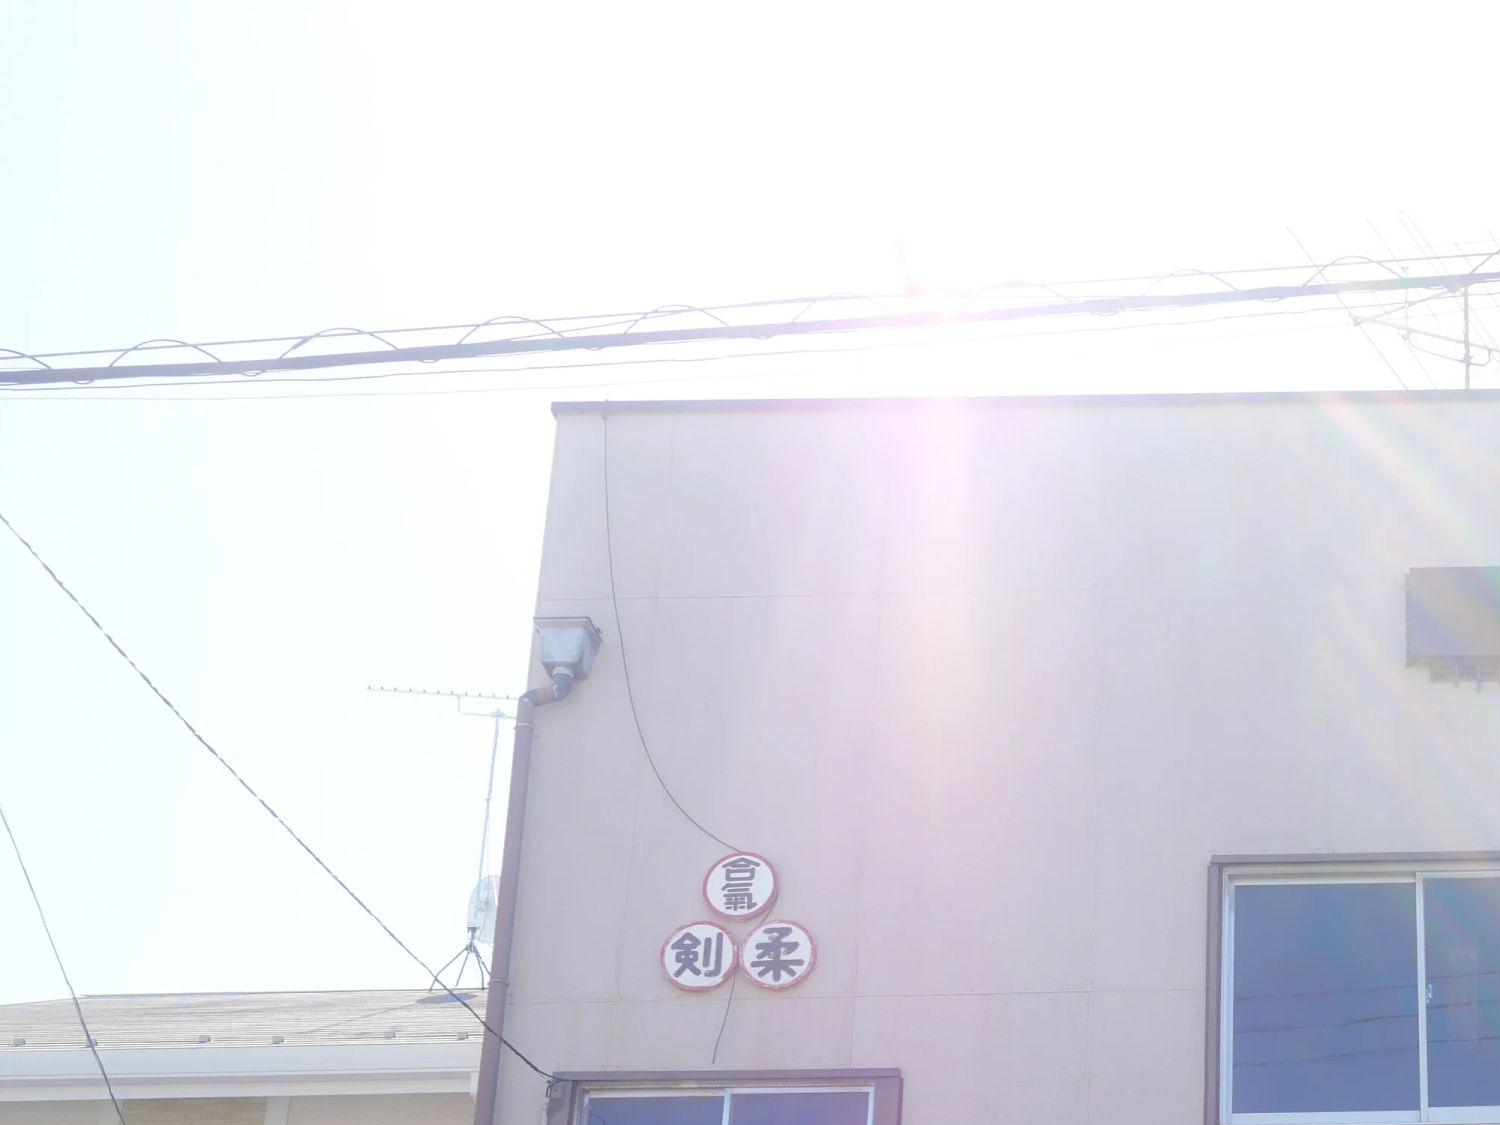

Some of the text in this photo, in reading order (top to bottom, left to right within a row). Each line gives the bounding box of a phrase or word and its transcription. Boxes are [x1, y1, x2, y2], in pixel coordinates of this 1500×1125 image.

[721, 857, 761, 912] 合氣
[670, 931, 724, 979] 剣
[750, 926, 805, 982] 柔
